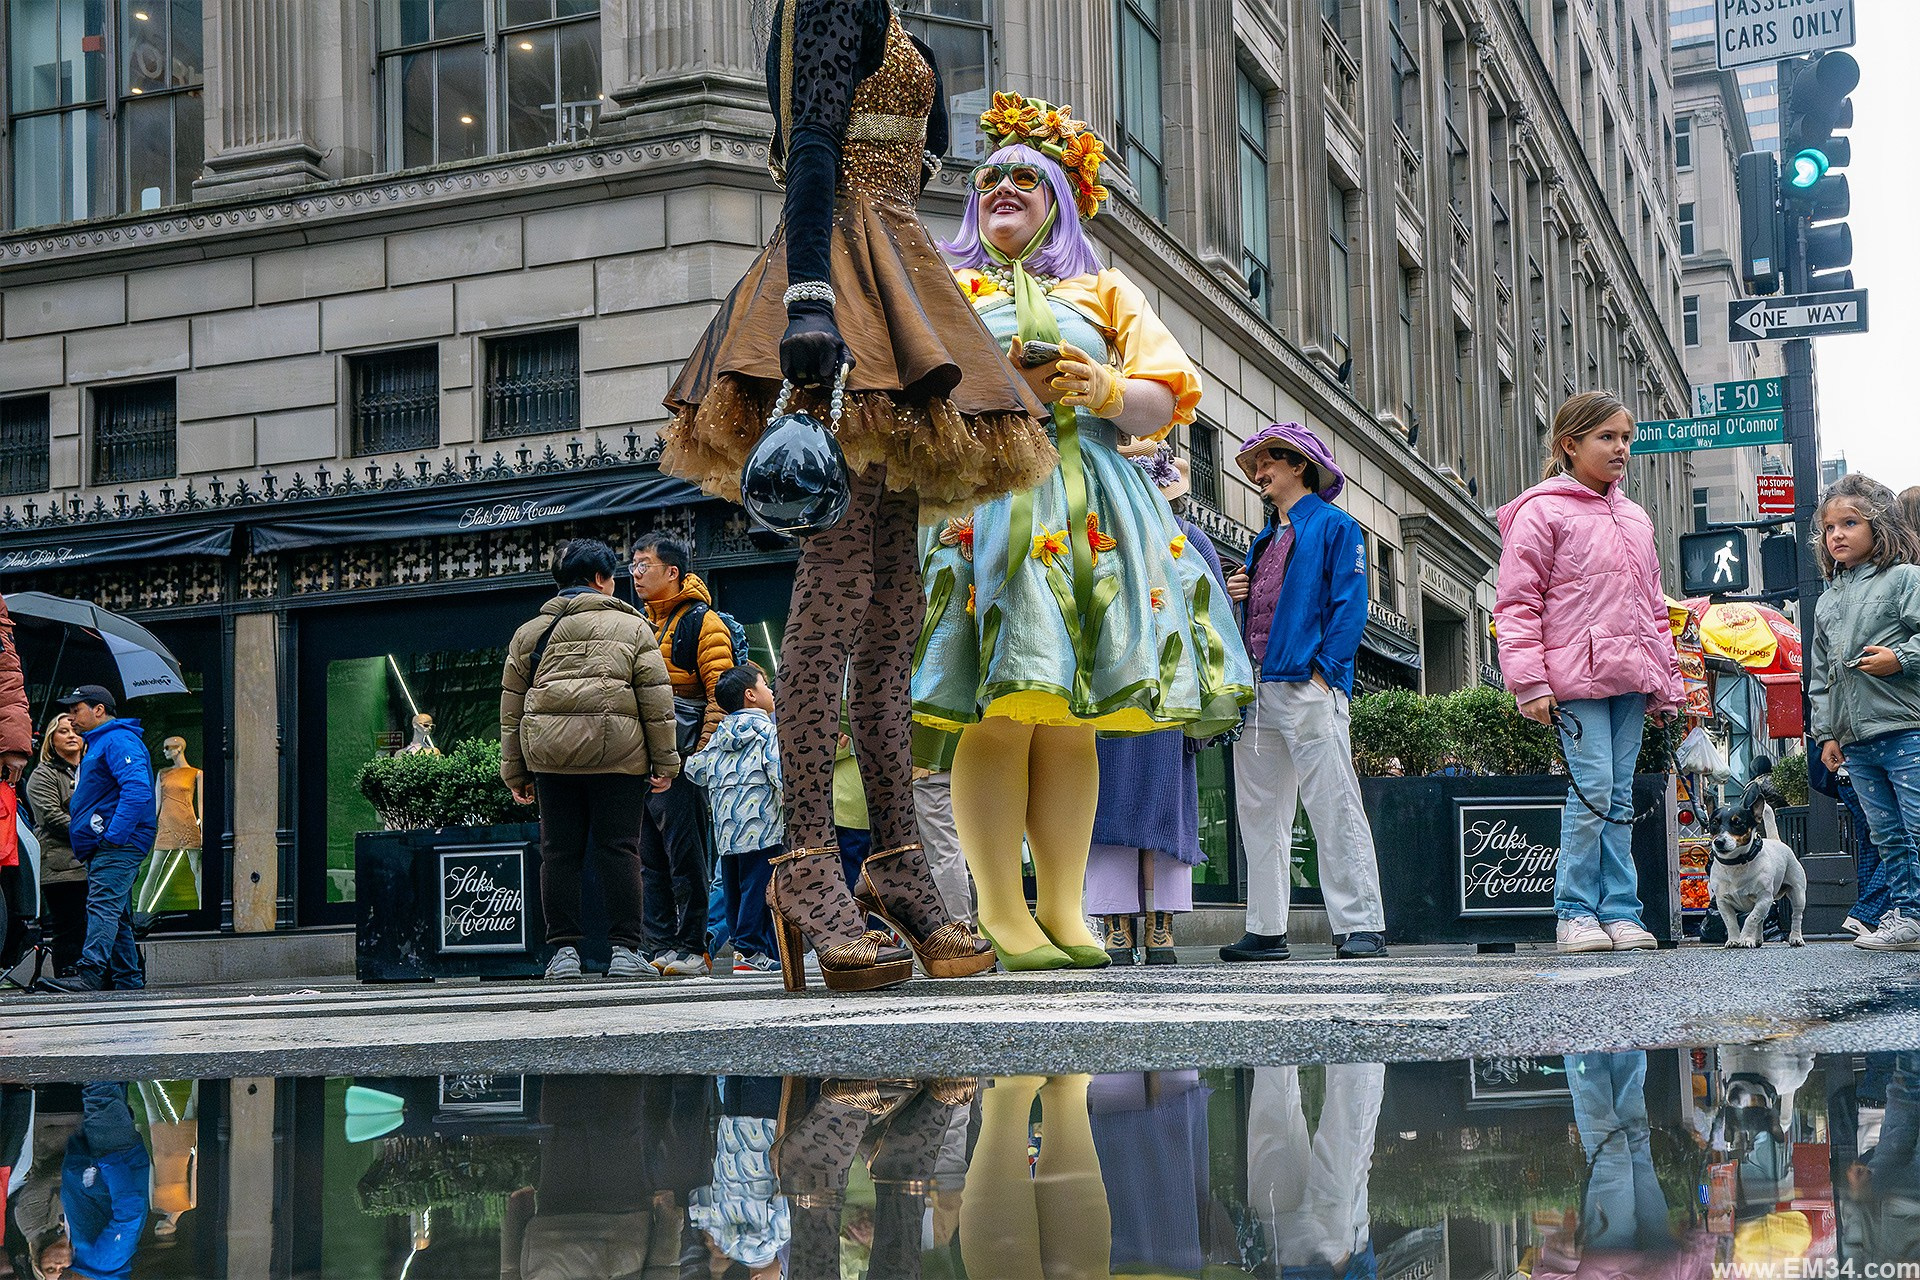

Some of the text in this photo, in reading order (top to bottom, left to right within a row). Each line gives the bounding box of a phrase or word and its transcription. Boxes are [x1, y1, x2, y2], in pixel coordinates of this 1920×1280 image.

[1725, 8, 1844, 52] CARS ONLY
[1749, 304, 1849, 328] ONE WAY
[1716, 387, 1728, 411] E
[1735, 383, 1759, 410] 50
[1668, 420, 1720, 439] Cardinal
[1726, 416, 1779, 435] O'Connor
[1697, 438, 1713, 448] Way
[1759, 479, 1795, 488] NO STOPPIN
[1760, 487, 1786, 497] Anytime
[458, 500, 566, 528] Saks Fifth Avenue
[1733, 646, 1748, 656] Hot
[1464, 819, 1527, 858] Saks
[1498, 844, 1560, 878] Fifth
[444, 865, 494, 900] Saks
[1464, 862, 1556, 899] Avenue
[471, 887, 522, 918] Fifth
[444, 904, 516, 937] Avenue
